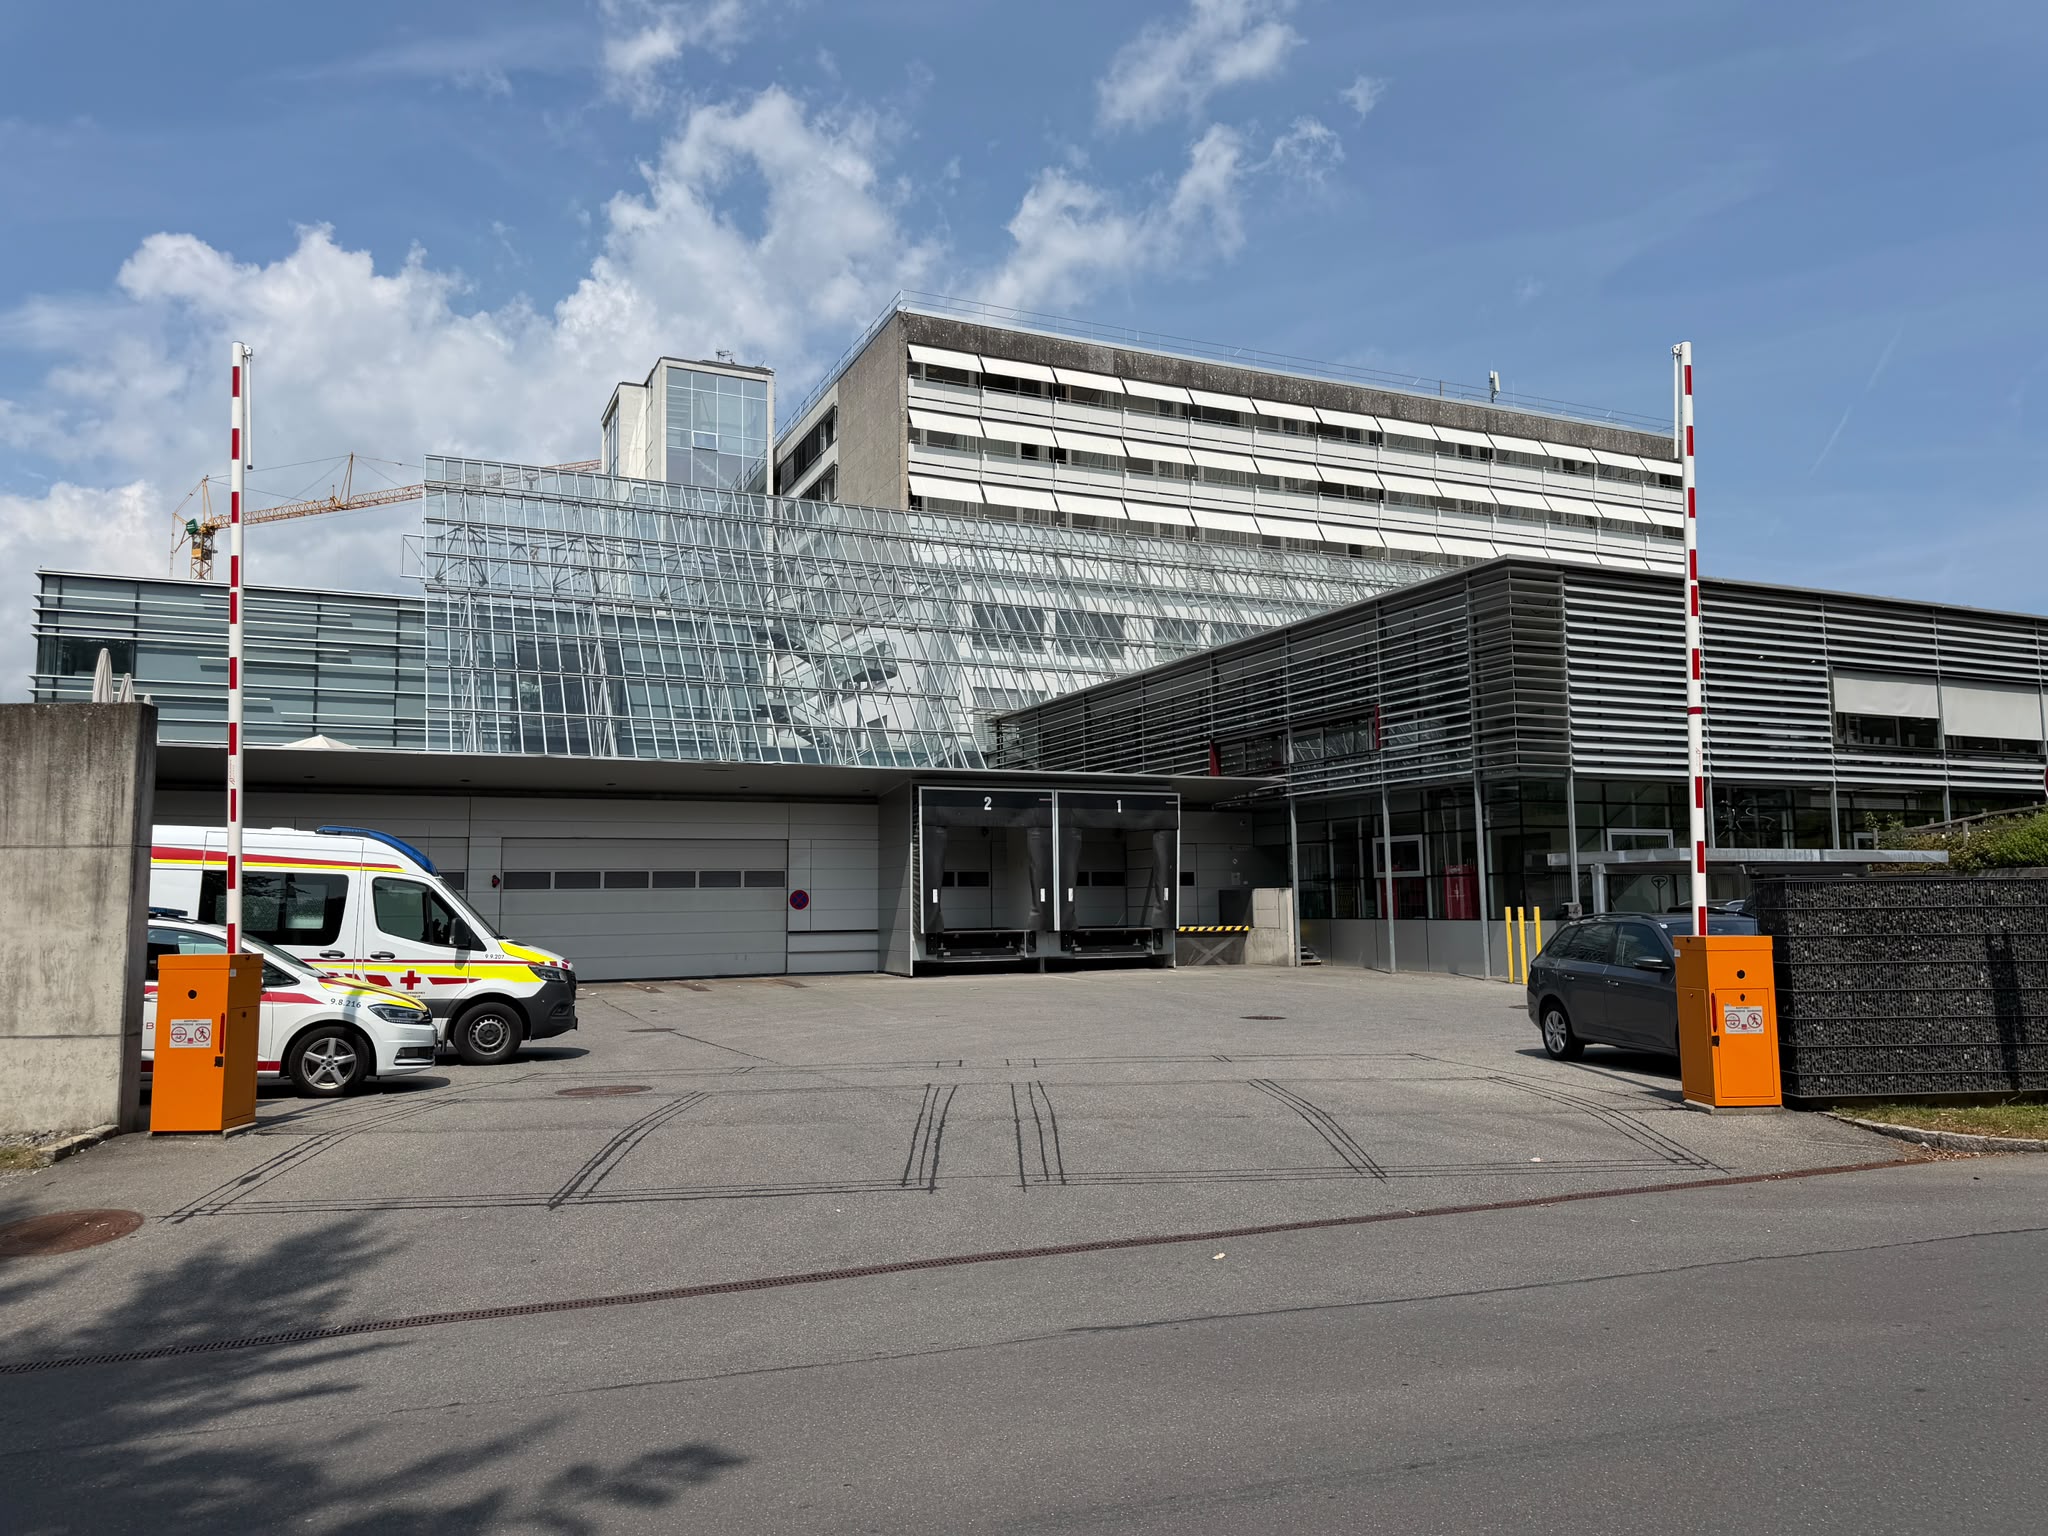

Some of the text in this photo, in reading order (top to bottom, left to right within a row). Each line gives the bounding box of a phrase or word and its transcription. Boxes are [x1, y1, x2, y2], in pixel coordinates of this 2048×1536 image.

[983, 796, 992, 811] 2
[1116, 799, 1122, 813] 1
[330, 997, 362, 1009] 9.8.216
